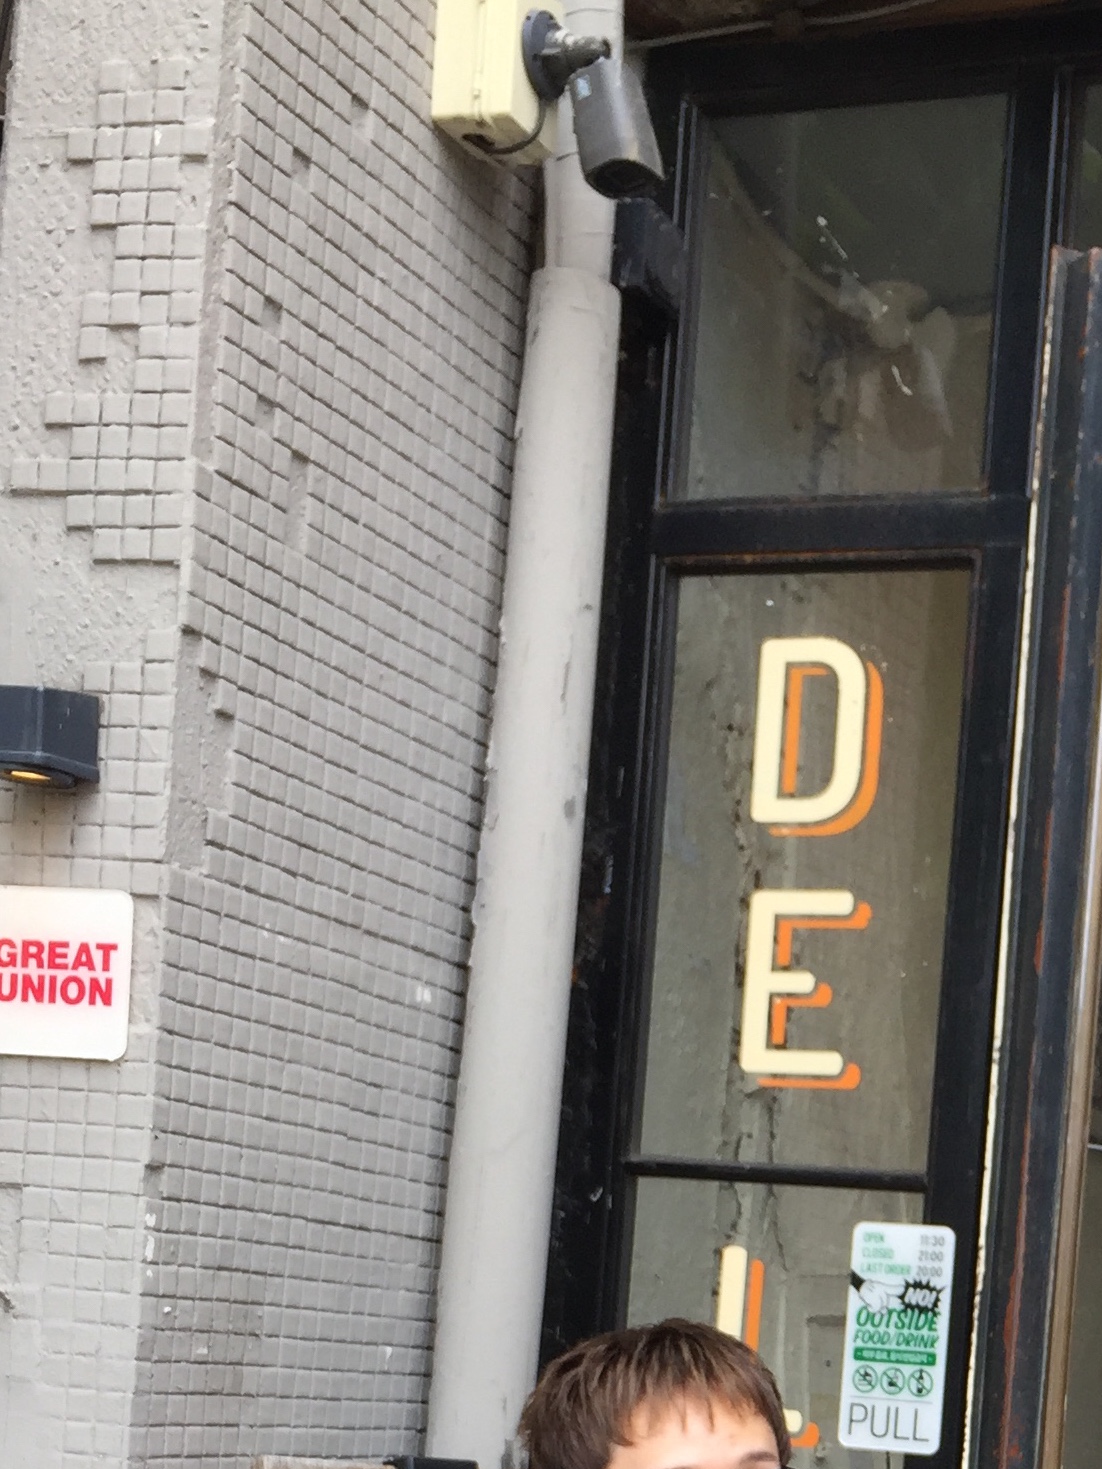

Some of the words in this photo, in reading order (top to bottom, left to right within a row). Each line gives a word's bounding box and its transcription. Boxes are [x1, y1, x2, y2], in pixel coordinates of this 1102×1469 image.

[0, 937, 118, 972] GREAT
[0, 972, 113, 1008] UNION
[903, 1286, 939, 1309] NO!
[847, 1402, 929, 1443] PULL
